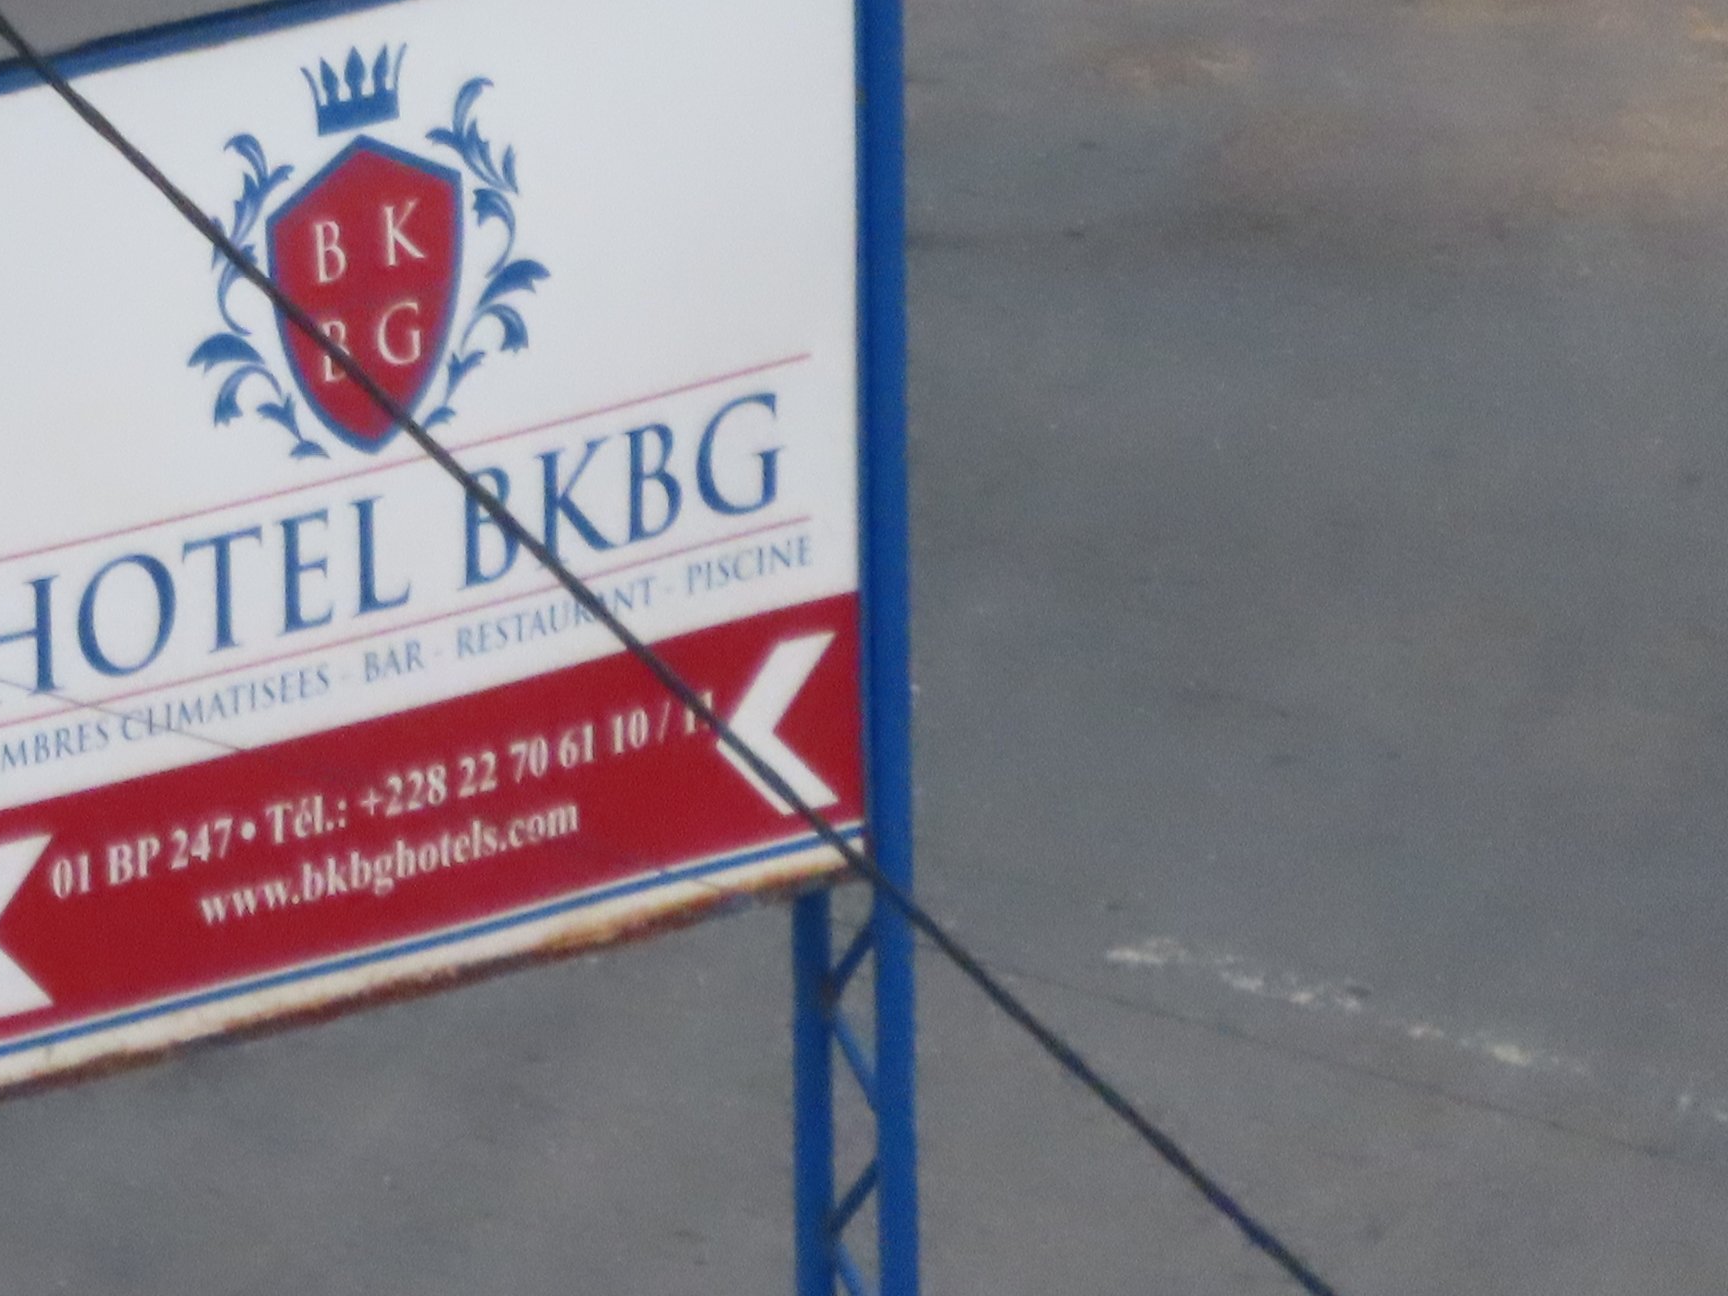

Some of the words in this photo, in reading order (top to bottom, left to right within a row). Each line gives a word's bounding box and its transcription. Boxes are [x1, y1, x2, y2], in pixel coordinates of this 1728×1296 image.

[458, 392, 785, 591] BKBG
[120, 664, 330, 741] CLIMATISEES
[363, 639, 425, 683] BAR
[456, 575, 659, 658] RESTAURNT
[686, 535, 813, 595] PISCINE
[50, 854, 91, 899] 01
[107, 837, 160, 886] BP
[361, 763, 446, 817] +228
[458, 751, 498, 799] 22
[509, 737, 548, 784] 70
[558, 723, 595, 769] 61
[611, 708, 648, 754] 10
[200, 804, 579, 925] www.bkbghotels.com
